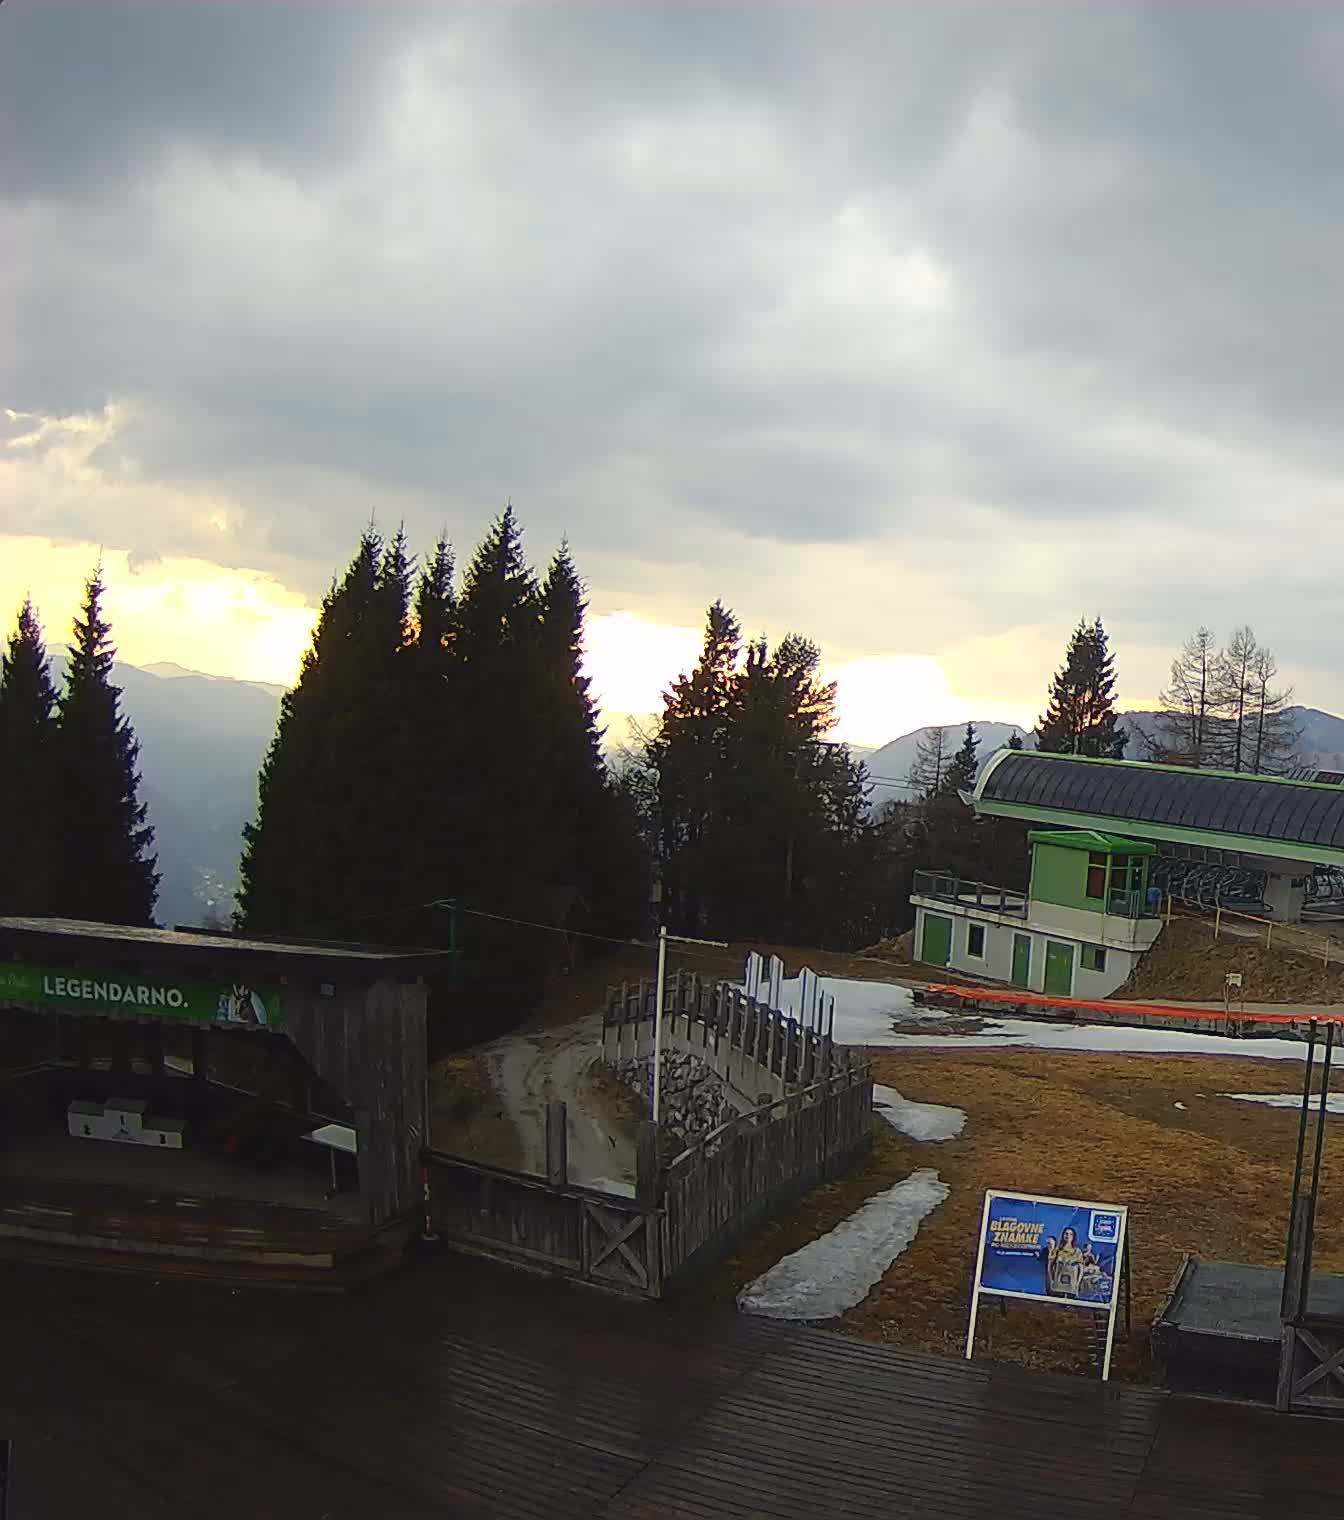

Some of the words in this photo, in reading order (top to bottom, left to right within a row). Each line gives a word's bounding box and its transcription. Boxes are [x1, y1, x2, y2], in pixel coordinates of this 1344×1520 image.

[43, 975, 189, 1008] LEGENDARNO.
[990, 1220, 1044, 1233] BLAGOVNE
[993, 1232, 1040, 1244] ZNAMKE
